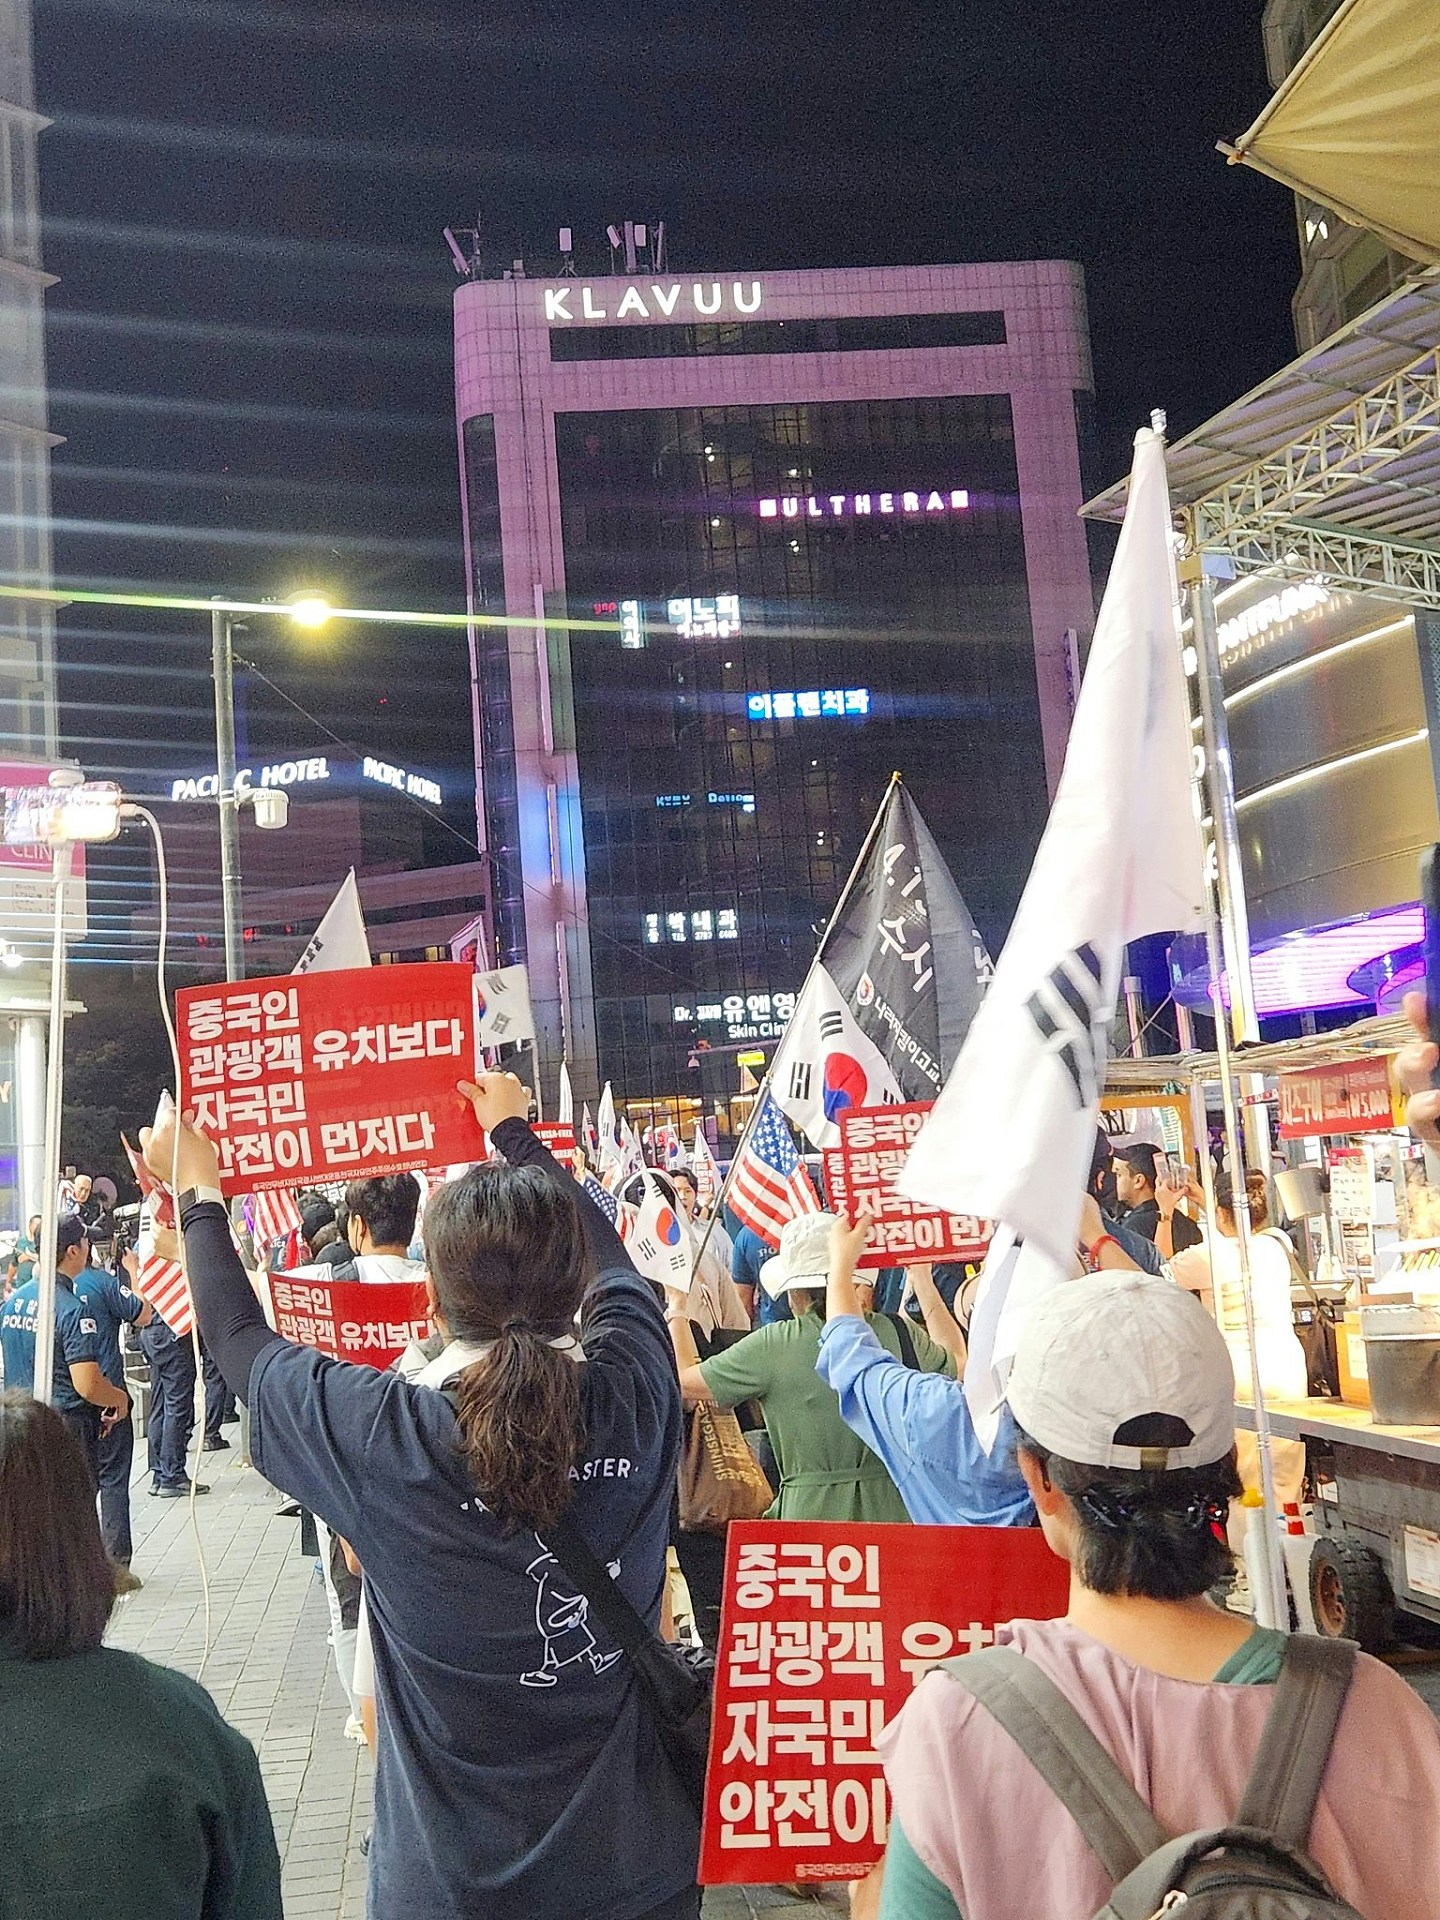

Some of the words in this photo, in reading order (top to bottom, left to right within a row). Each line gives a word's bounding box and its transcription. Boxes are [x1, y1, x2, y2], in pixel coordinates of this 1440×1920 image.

[544, 281, 762, 320] KLAVUU
[782, 490, 945, 517] ULTHERA
[171, 769, 252, 801] PACIC
[260, 757, 330, 788] HOTEL
[362, 757, 406, 790] PACIFIC
[407, 774, 442, 805] HOTEL
[187, 988, 300, 1042] 중국인
[723, 992, 799, 1023] 유앤영
[188, 1034, 303, 1088] 관광객
[312, 1018, 465, 1072] 유치보다
[728, 1024, 758, 1039] Skin
[191, 1080, 307, 1132] 자국민
[320, 1111, 436, 1165] 먼저다
[849, 1149, 911, 1185] 관광
[273, 1281, 333, 1317] 중국인
[3, 1314, 39, 1333] POLICE
[278, 1312, 338, 1349] 관광객
[340, 1319, 437, 1351] 유치보다
[568, 1457, 632, 1482] ASTER
[735, 1543, 881, 1609] 중국인
[728, 1621, 885, 1687] 관광객
[722, 1699, 885, 1766] 자국민
[719, 1778, 887, 1850] 안전이
